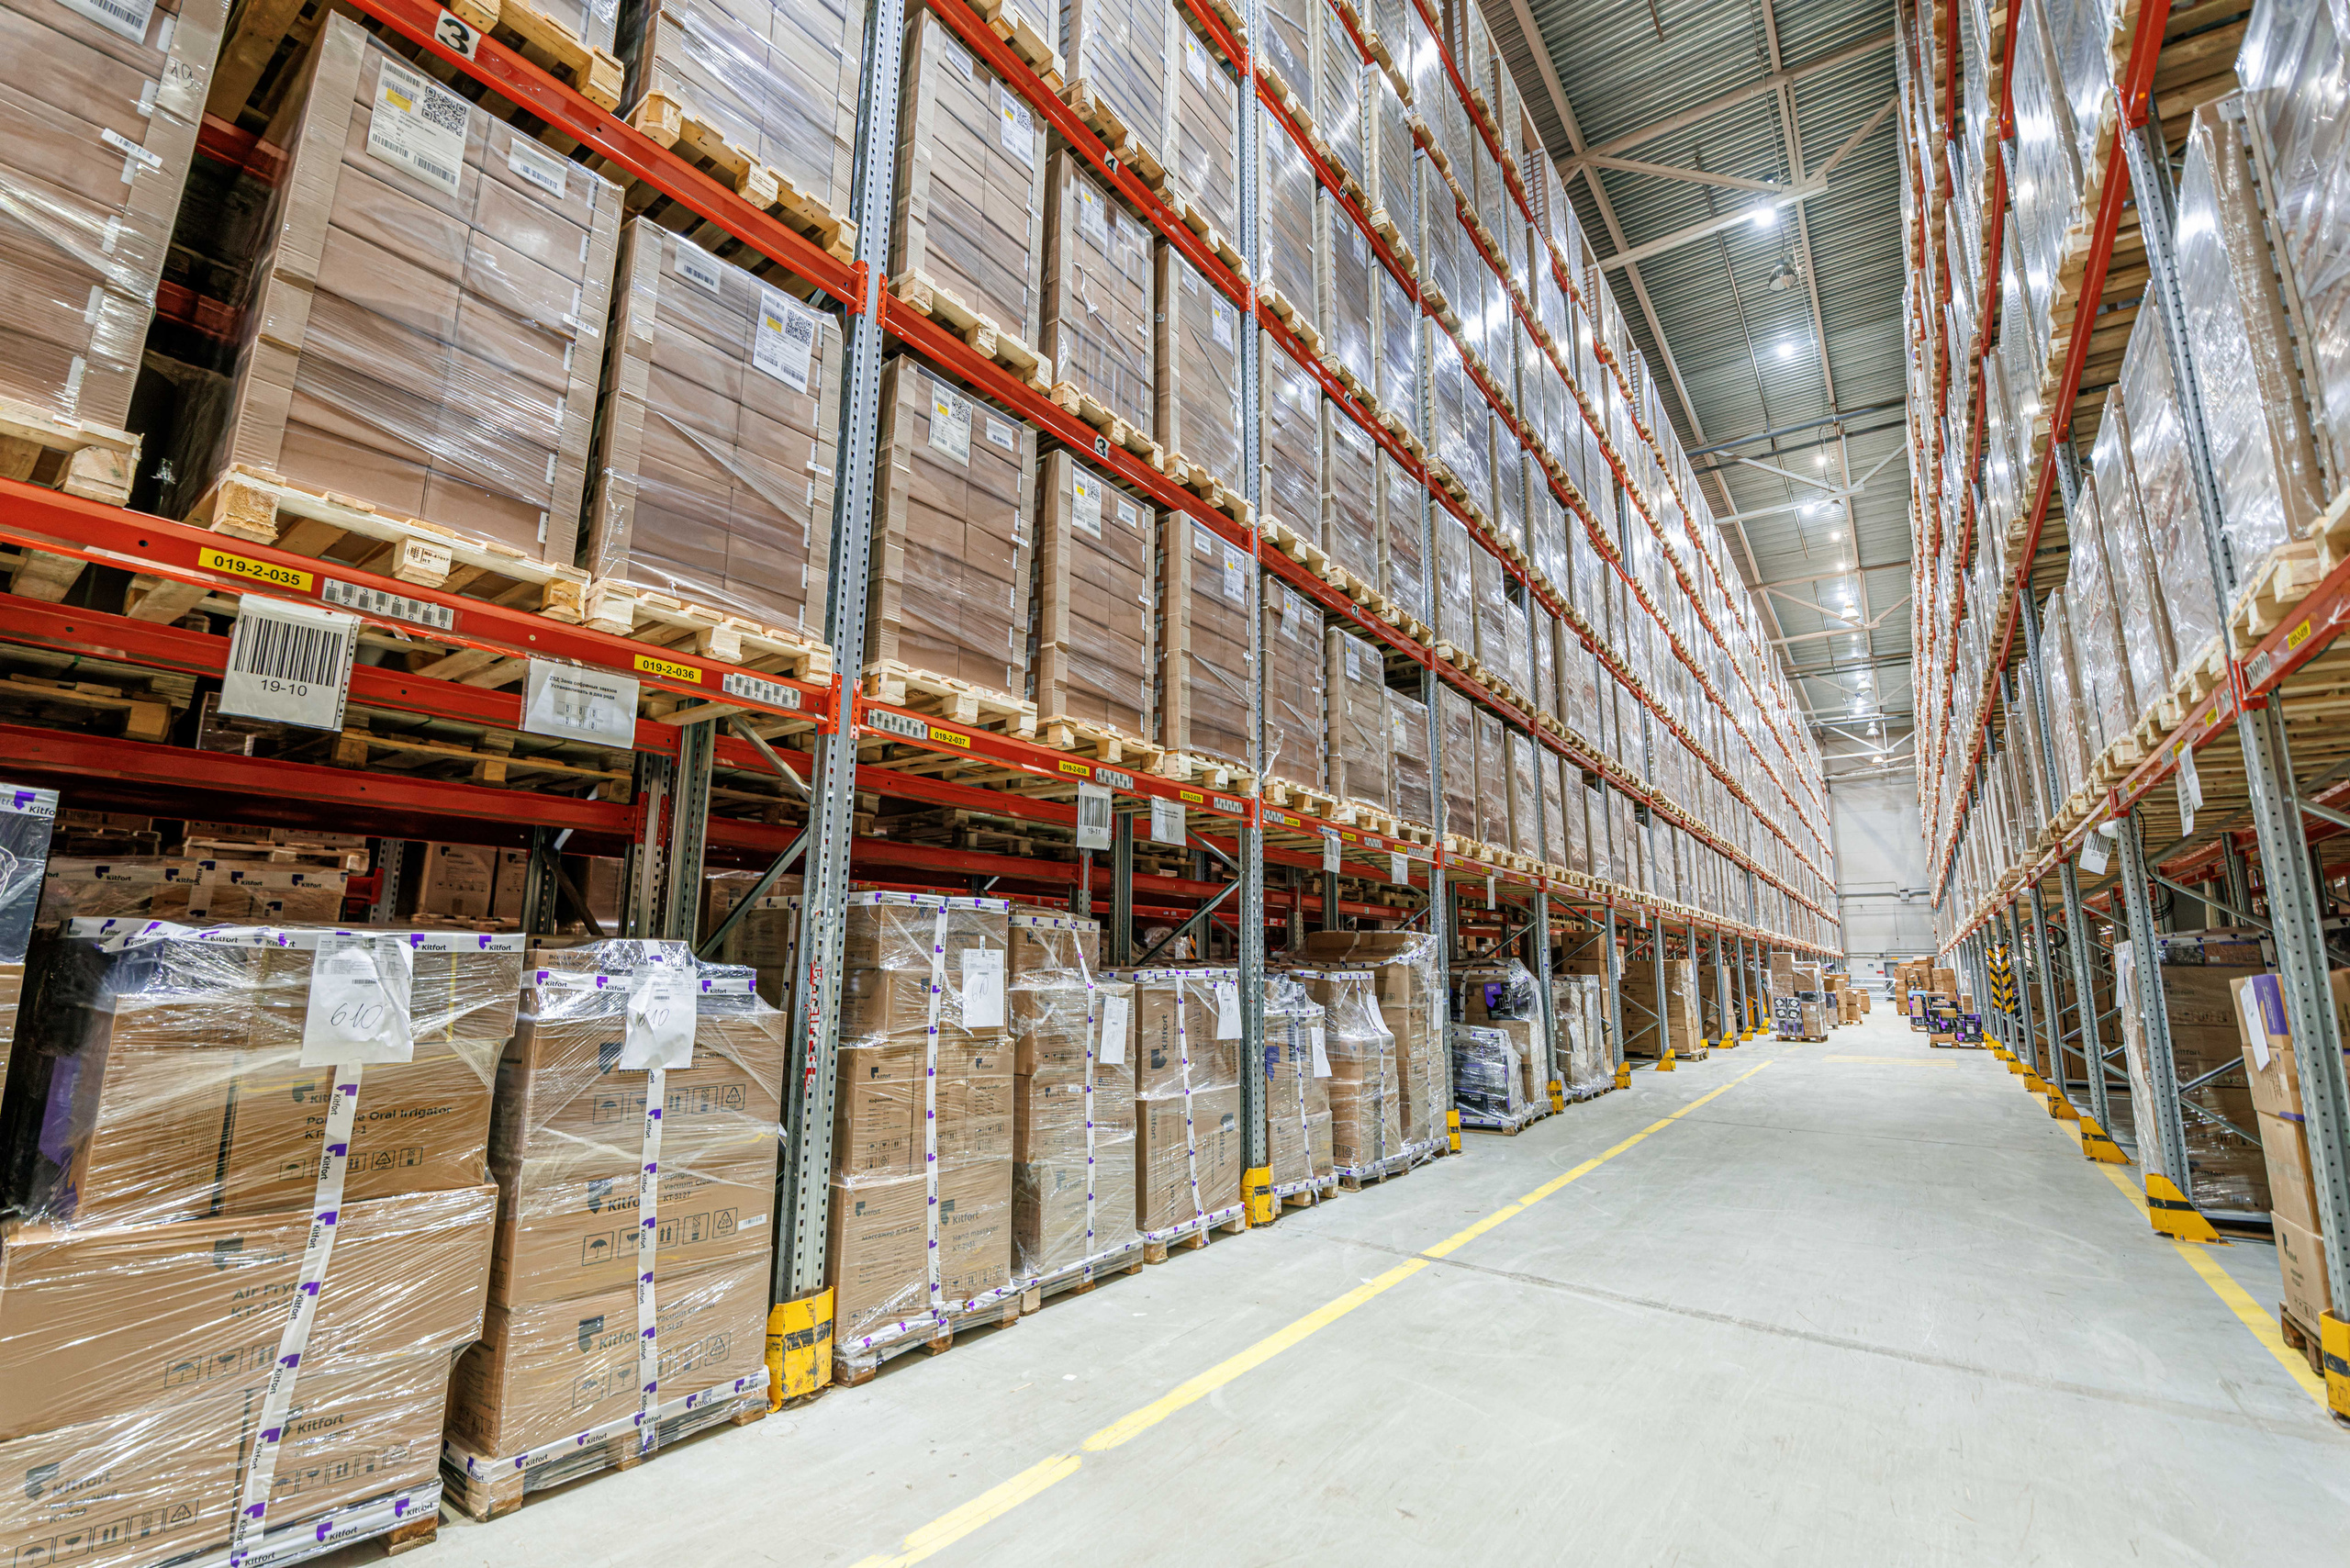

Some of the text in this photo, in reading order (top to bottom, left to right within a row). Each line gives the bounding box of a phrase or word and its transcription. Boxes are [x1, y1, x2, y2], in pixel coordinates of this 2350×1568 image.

[435, 18, 473, 53] 3
[1096, 439, 1106, 457] 3
[214, 554, 301, 586] 019-2-035
[408, 611, 414, 620] 6
[439, 620, 446, 628] 8
[643, 660, 695, 680] 019-2-036
[260, 679, 308, 697] 19-10
[934, 732, 966, 745] 019-2-037
[1062, 764, 1087, 775] 019-2-038
[1087, 827, 1101, 835] 19-11
[330, 1002, 383, 1029] 610
[330, 1093, 341, 1115] Kitfort
[369, 1105, 453, 1121] Oral Irrigator
[320, 1156, 331, 1181] Kitfort
[608, 1196, 640, 1212] Kitfo
[953, 1211, 979, 1225] Kitfort
[308, 1224, 320, 1249] Kitfort
[953, 1233, 968, 1242] Hand
[232, 1282, 298, 1301] Air Frye
[290, 1294, 303, 1320] Kitfort
[599, 1331, 639, 1351] Kitfor
[269, 1369, 283, 1394] Kitfort
[742, 1383, 758, 1393] Kitfort
[694, 1398, 711, 1408] Kitfort
[297, 1414, 344, 1434] Kitfort
[643, 1414, 662, 1425] Kitfort
[587, 1432, 608, 1445] Kitfort
[250, 1442, 263, 1471] Kitfort
[525, 1453, 548, 1467] Kitfort
[236, 1519, 248, 1546] Kitfort
[330, 1527, 358, 1540] Kitfort
[245, 1551, 275, 1566] Kitfort
